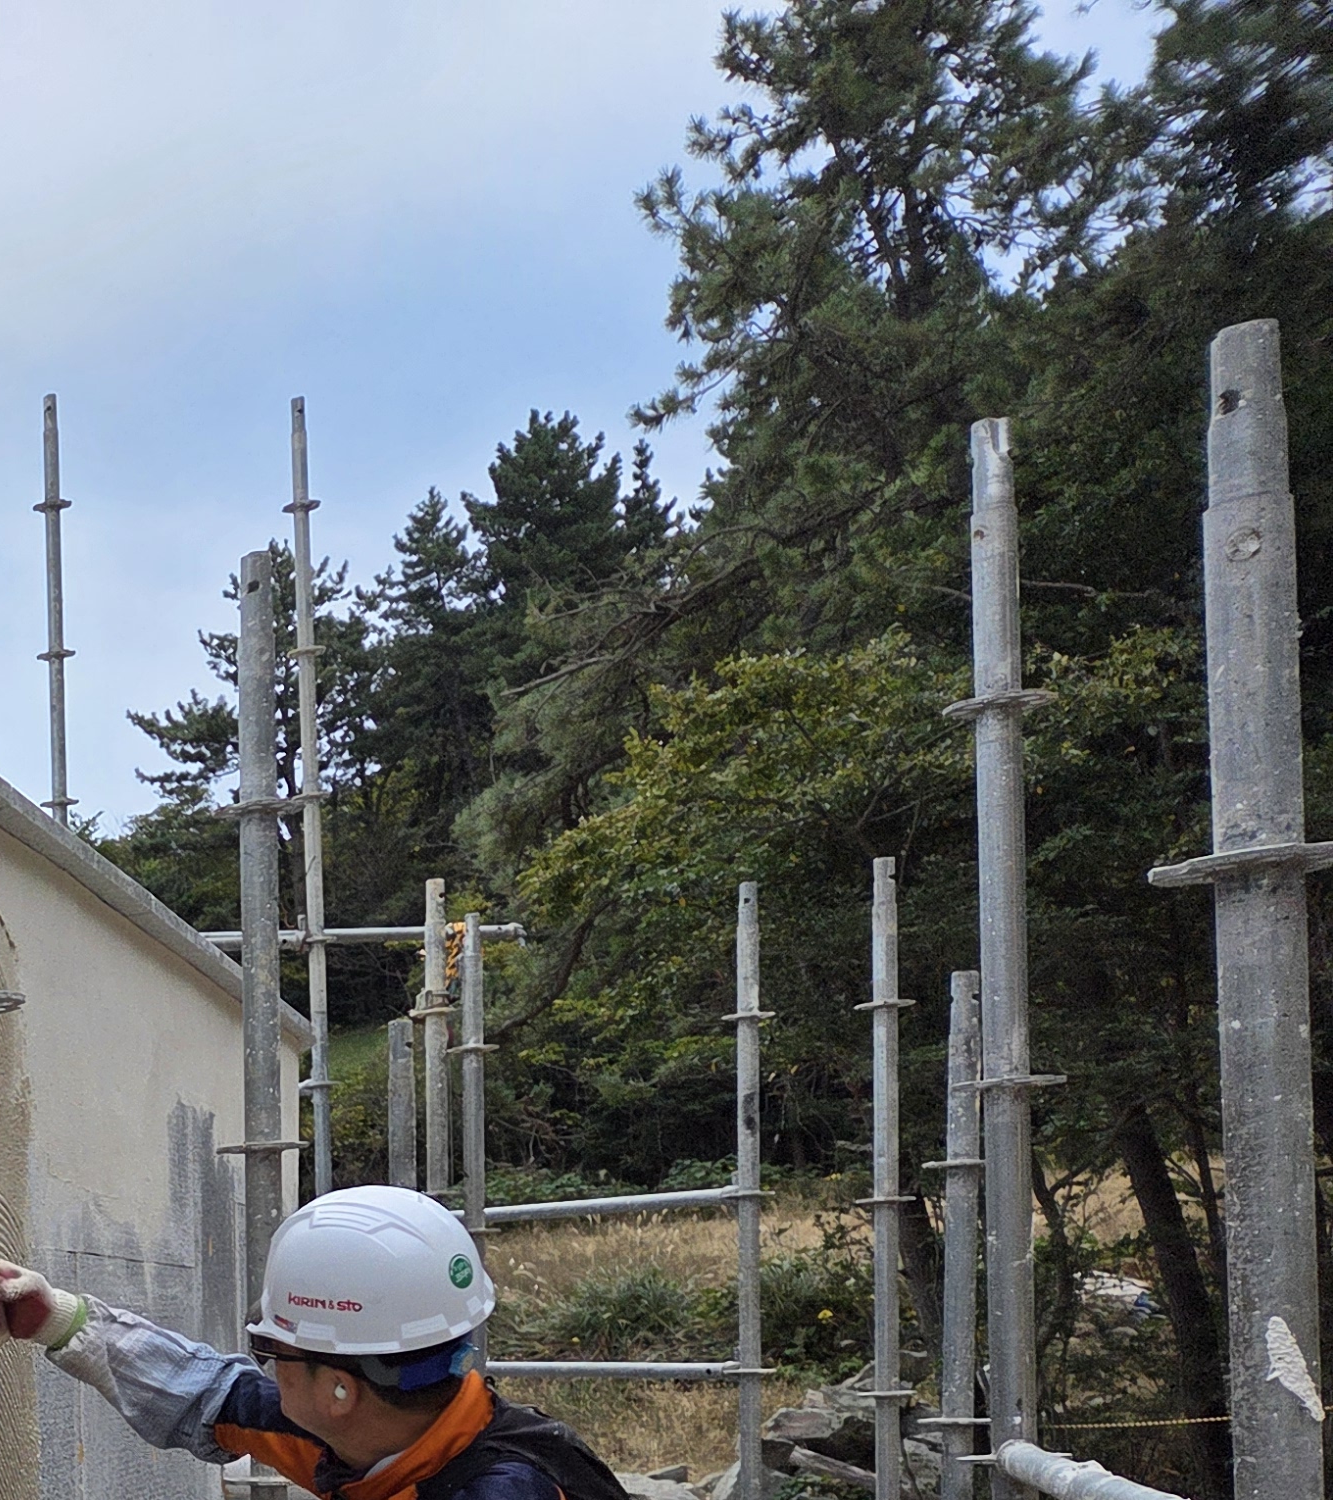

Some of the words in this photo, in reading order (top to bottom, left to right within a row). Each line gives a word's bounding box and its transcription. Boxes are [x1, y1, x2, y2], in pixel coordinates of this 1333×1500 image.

[288, 1291, 326, 1310] KIRIN
[328, 1300, 335, 1310] &
[336, 1299, 363, 1312] sto
